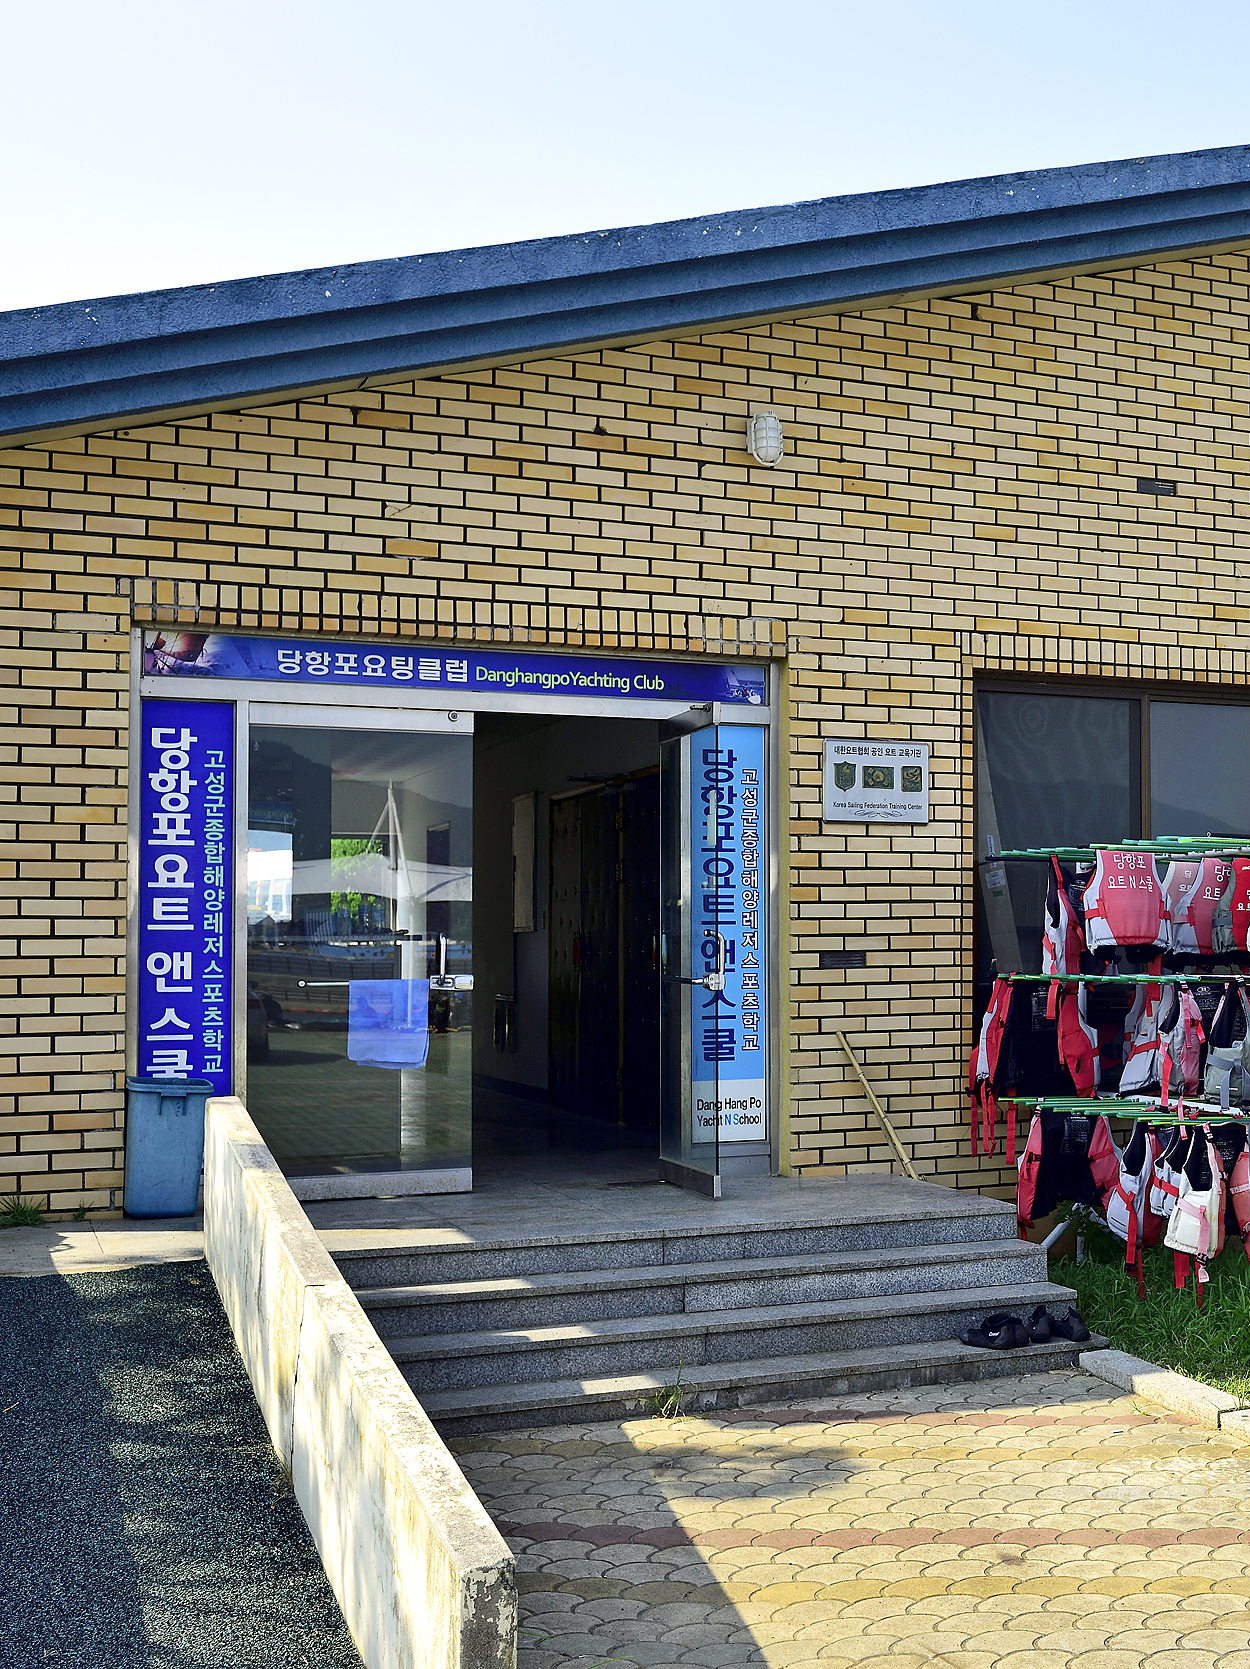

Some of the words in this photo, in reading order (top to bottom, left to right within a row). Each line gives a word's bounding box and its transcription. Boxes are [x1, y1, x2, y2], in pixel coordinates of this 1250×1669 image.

[277, 648, 469, 683] 당항포요팅클럽
[634, 674, 666, 691] Club
[847, 801, 863, 809] Sailing
[147, 727, 198, 931] 당항포요트
[1113, 853, 1147, 870] 당항포
[1107, 875, 1128, 888] 요트
[1128, 875, 1136, 888] N
[1138, 876, 1154, 893] 스쿨
[697, 1099, 722, 1111] Dang
[724, 1098, 748, 1110] Hang
[749, 1096, 762, 1108] Po
[696, 1114, 723, 1127] Yacht
[724, 1113, 732, 1125] N
[733, 1112, 762, 1125] School
